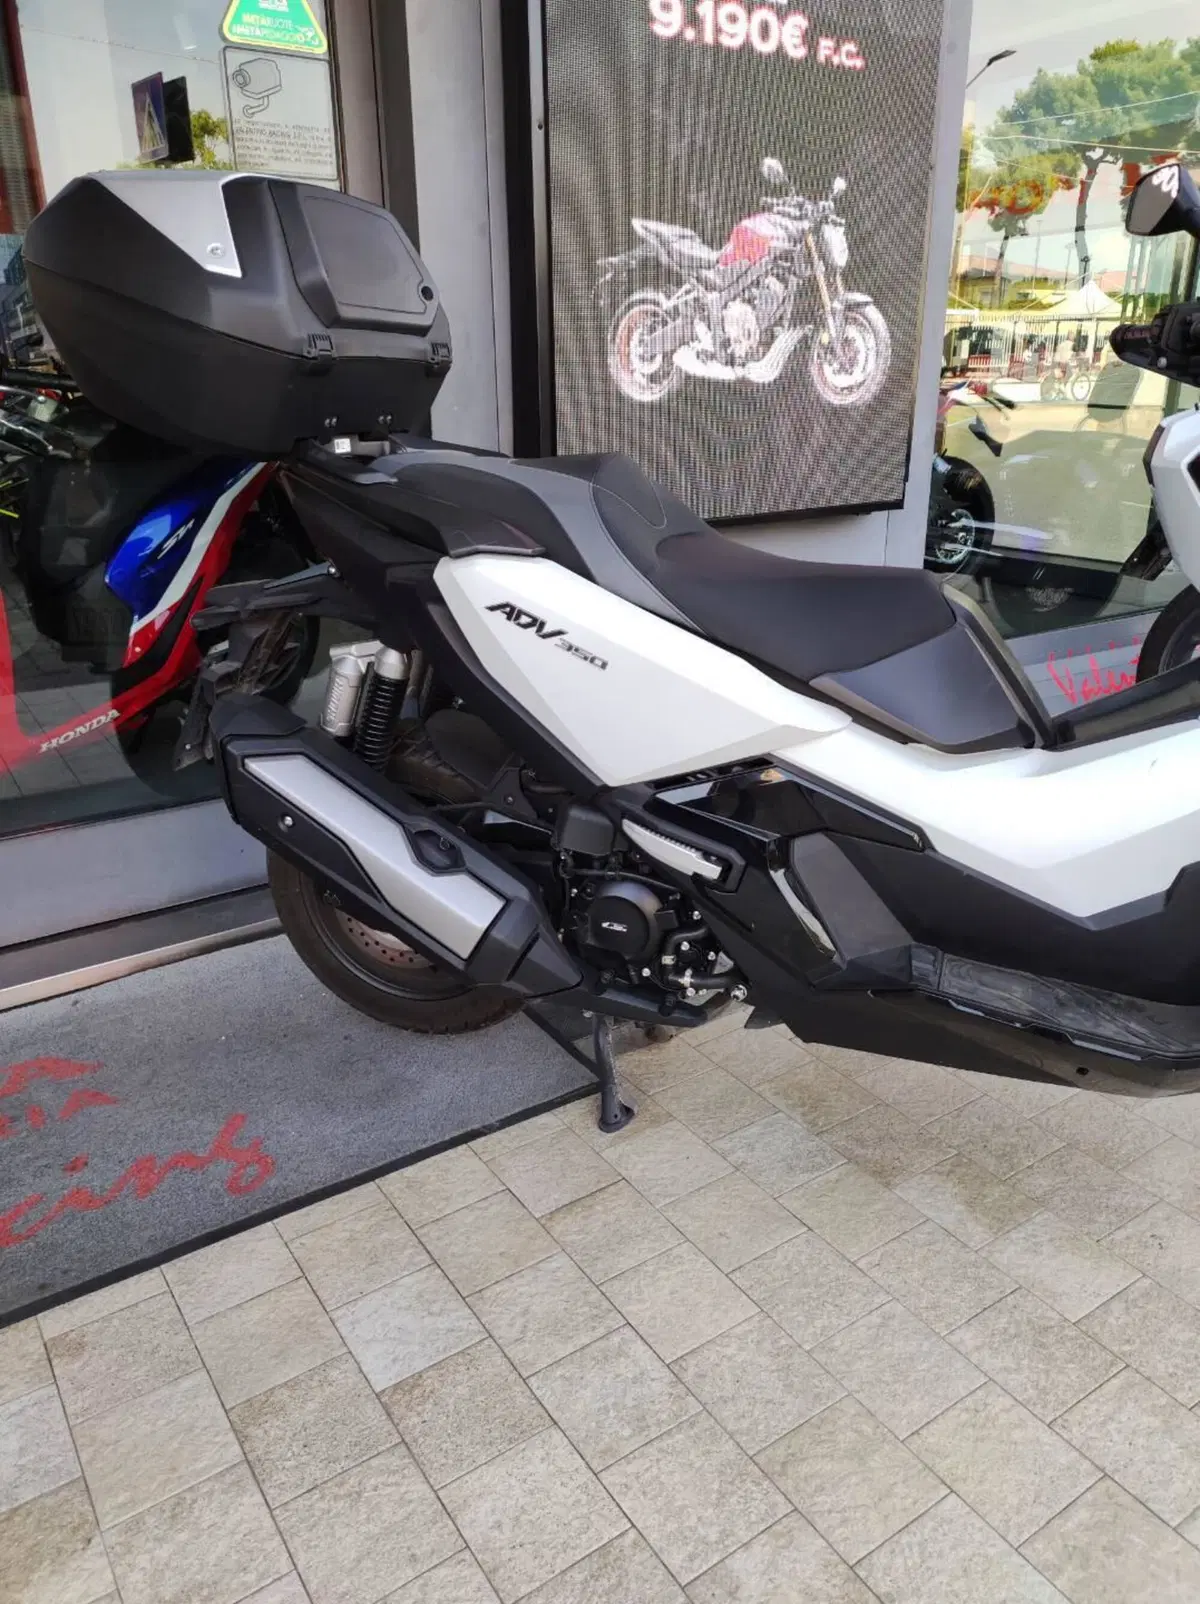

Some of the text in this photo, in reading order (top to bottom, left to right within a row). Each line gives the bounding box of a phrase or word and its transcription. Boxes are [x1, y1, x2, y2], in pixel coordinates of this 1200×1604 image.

[648, 0, 865, 70] 9.190€ F.C.
[485, 601, 609, 670] ADV 350
[39, 708, 121, 754] HONDA
